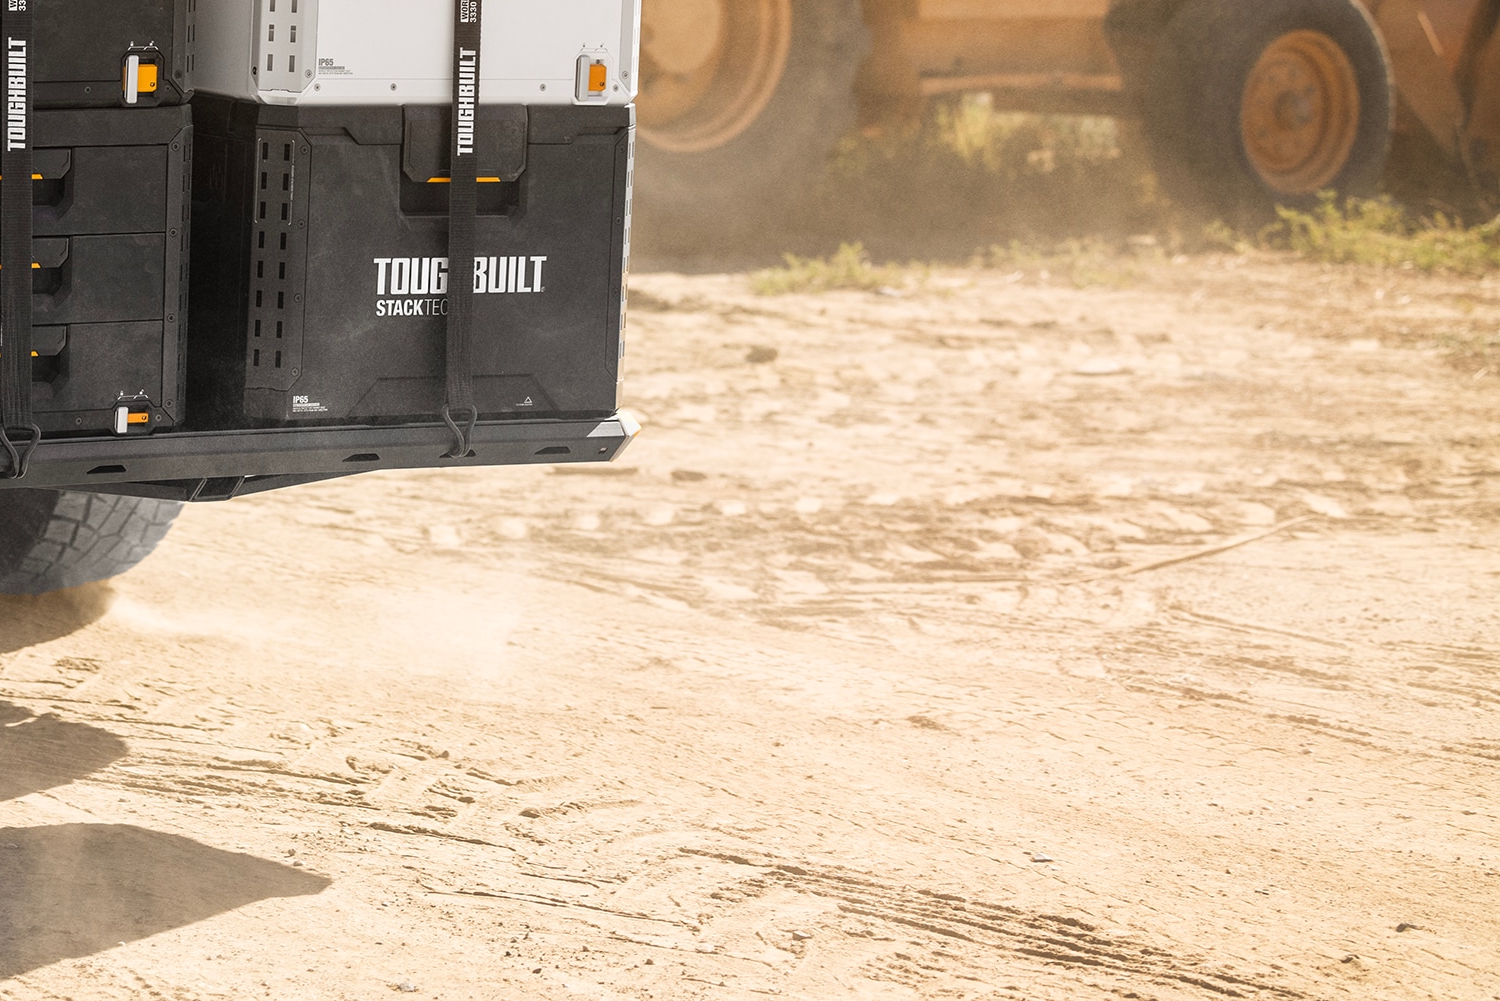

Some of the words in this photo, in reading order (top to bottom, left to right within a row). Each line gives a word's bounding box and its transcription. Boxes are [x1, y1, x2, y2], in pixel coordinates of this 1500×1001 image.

[470, 1, 478, 23] 3330
[8, 37, 27, 152] TOUGHBUILT
[457, 47, 476, 156] TOUGHBUILT
[373, 256, 548, 295] TOUGBUILT
[375, 299, 449, 316] STACKTEC
